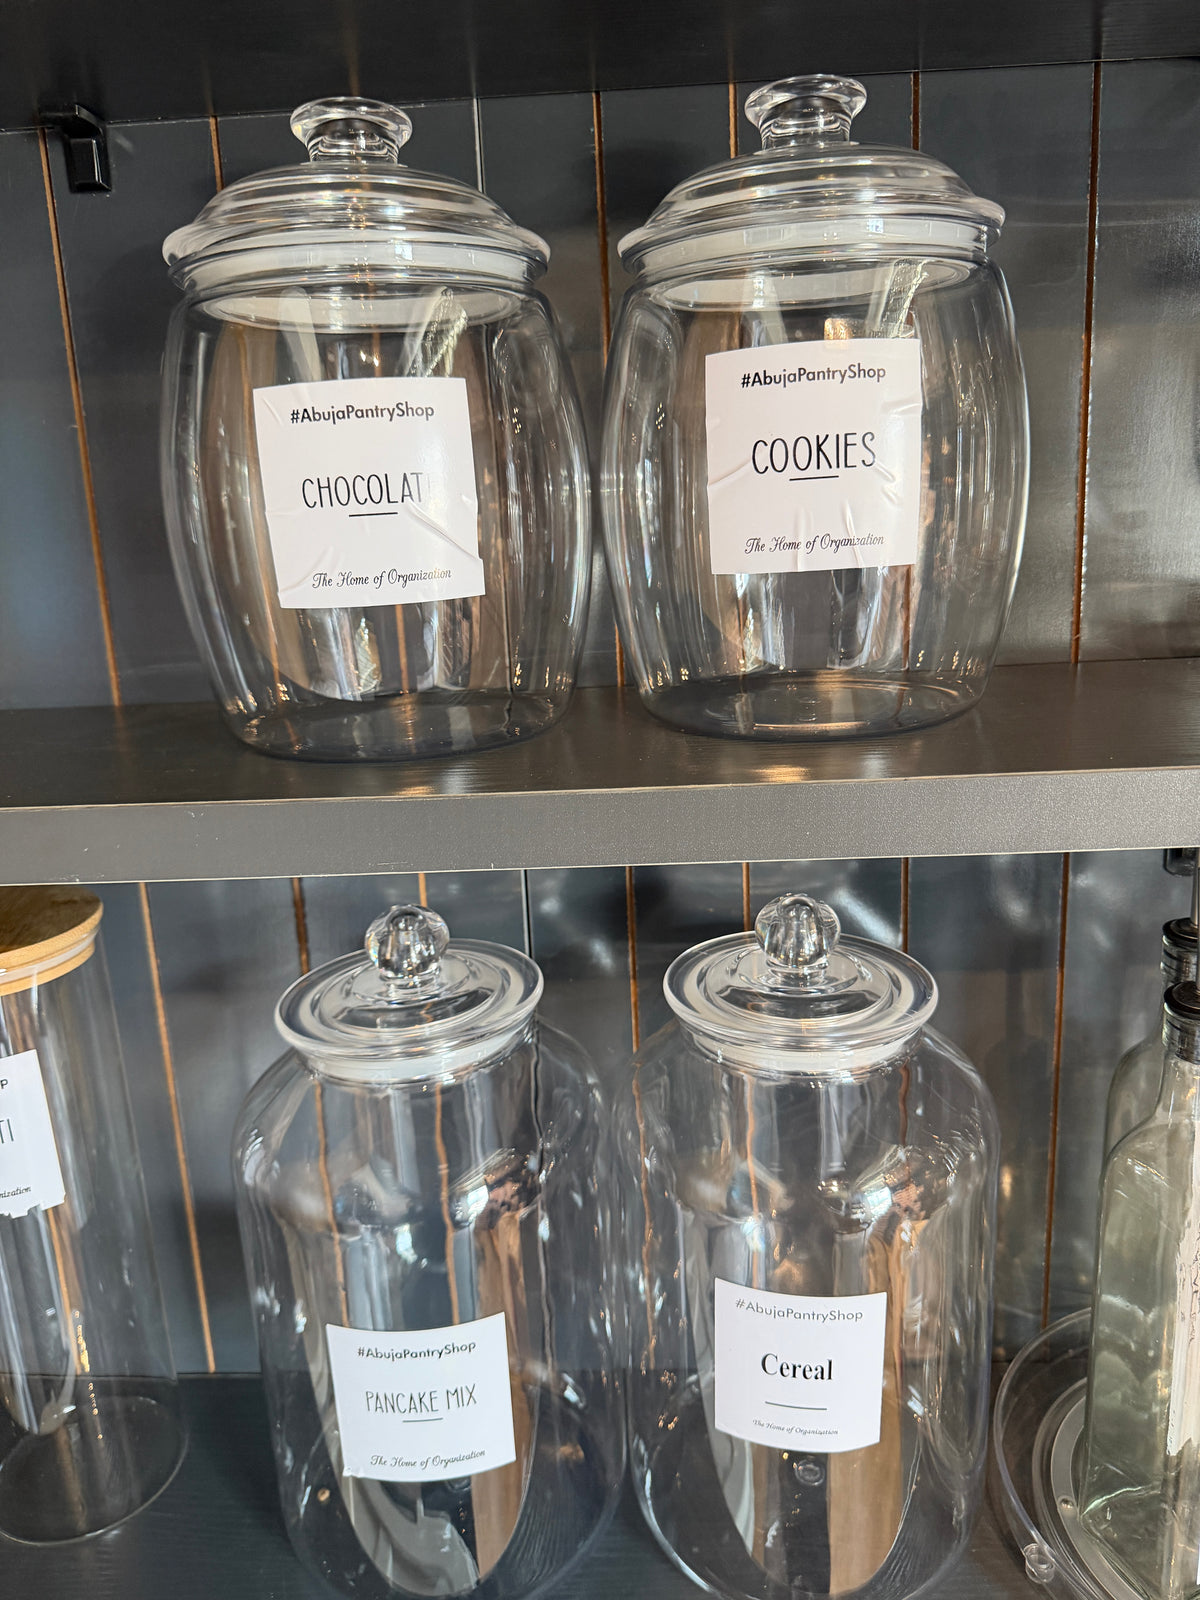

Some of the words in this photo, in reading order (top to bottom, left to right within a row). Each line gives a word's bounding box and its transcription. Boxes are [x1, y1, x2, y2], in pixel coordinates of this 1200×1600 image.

[740, 363, 886, 388] #AbujaPantryShop
[290, 401, 435, 424] #AbujaPantryShop
[752, 431, 876, 474] COOKIES
[744, 538, 766, 555] The
[769, 536, 802, 553] Home
[805, 535, 820, 554] of
[820, 532, 885, 553] Organization
[312, 573, 333, 589] The
[336, 571, 370, 588] Home
[373, 570, 387, 589] of
[387, 568, 452, 588] Organization
[736, 1298, 863, 1323] #AbujaPantryShop
[358, 1342, 476, 1362] #AbujaPantryShop
[761, 1352, 833, 1381] Cereal
[365, 1390, 439, 1414] PANCAKE
[446, 1383, 478, 1410] MIX
[752, 1419, 765, 1428] The
[766, 1423, 785, 1432] Home
[370, 1454, 388, 1466] The
[390, 1456, 417, 1468] Home
[420, 1456, 431, 1471] of
